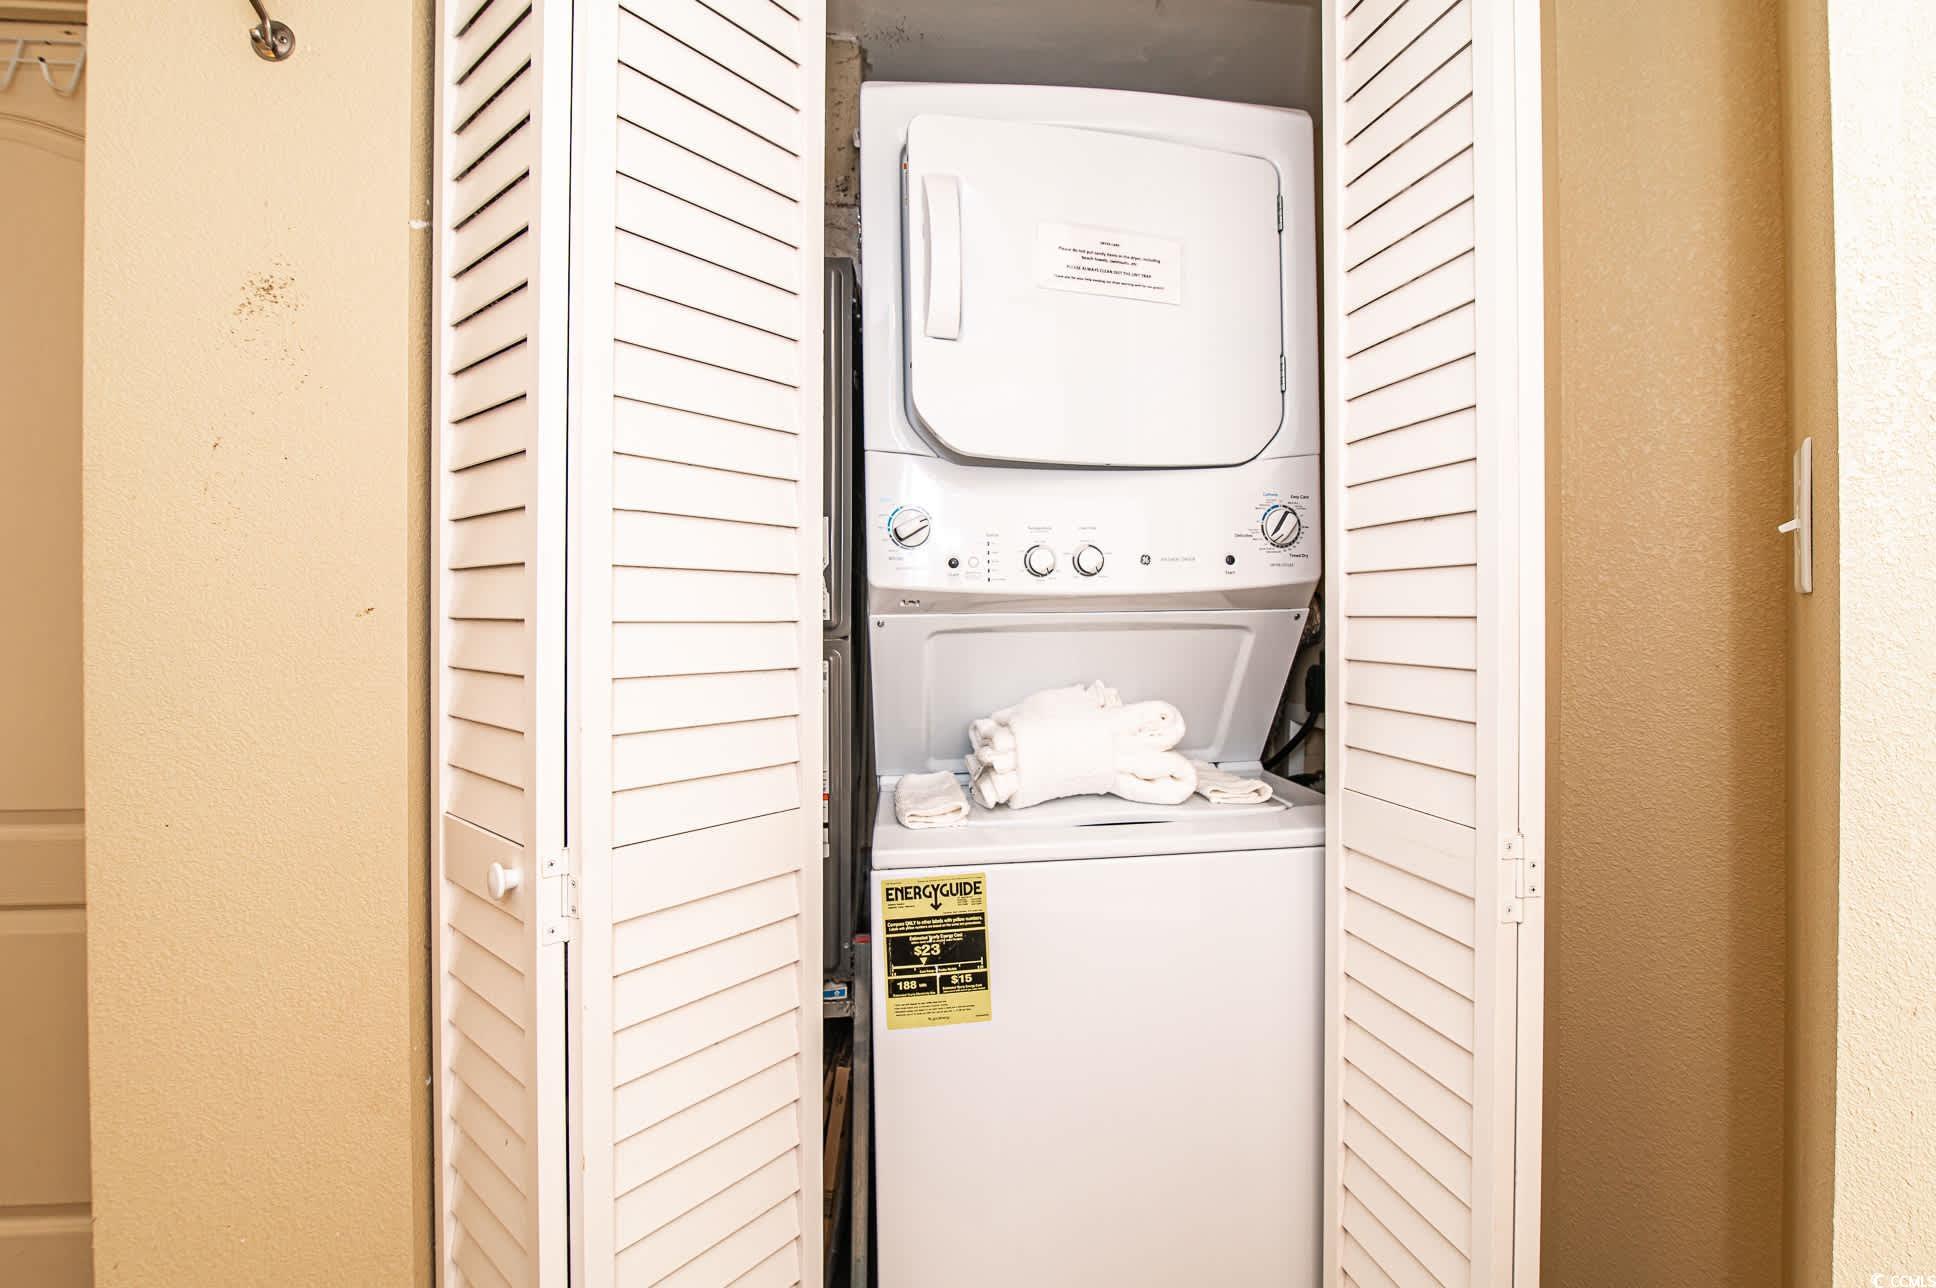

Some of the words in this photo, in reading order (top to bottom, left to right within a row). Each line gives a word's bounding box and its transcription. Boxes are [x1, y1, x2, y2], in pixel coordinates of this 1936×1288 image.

[885, 881, 982, 902] ENERGYGUIDE
[914, 944, 940, 956] $23
[950, 974, 972, 984] $15
[896, 980, 917, 990] 188
